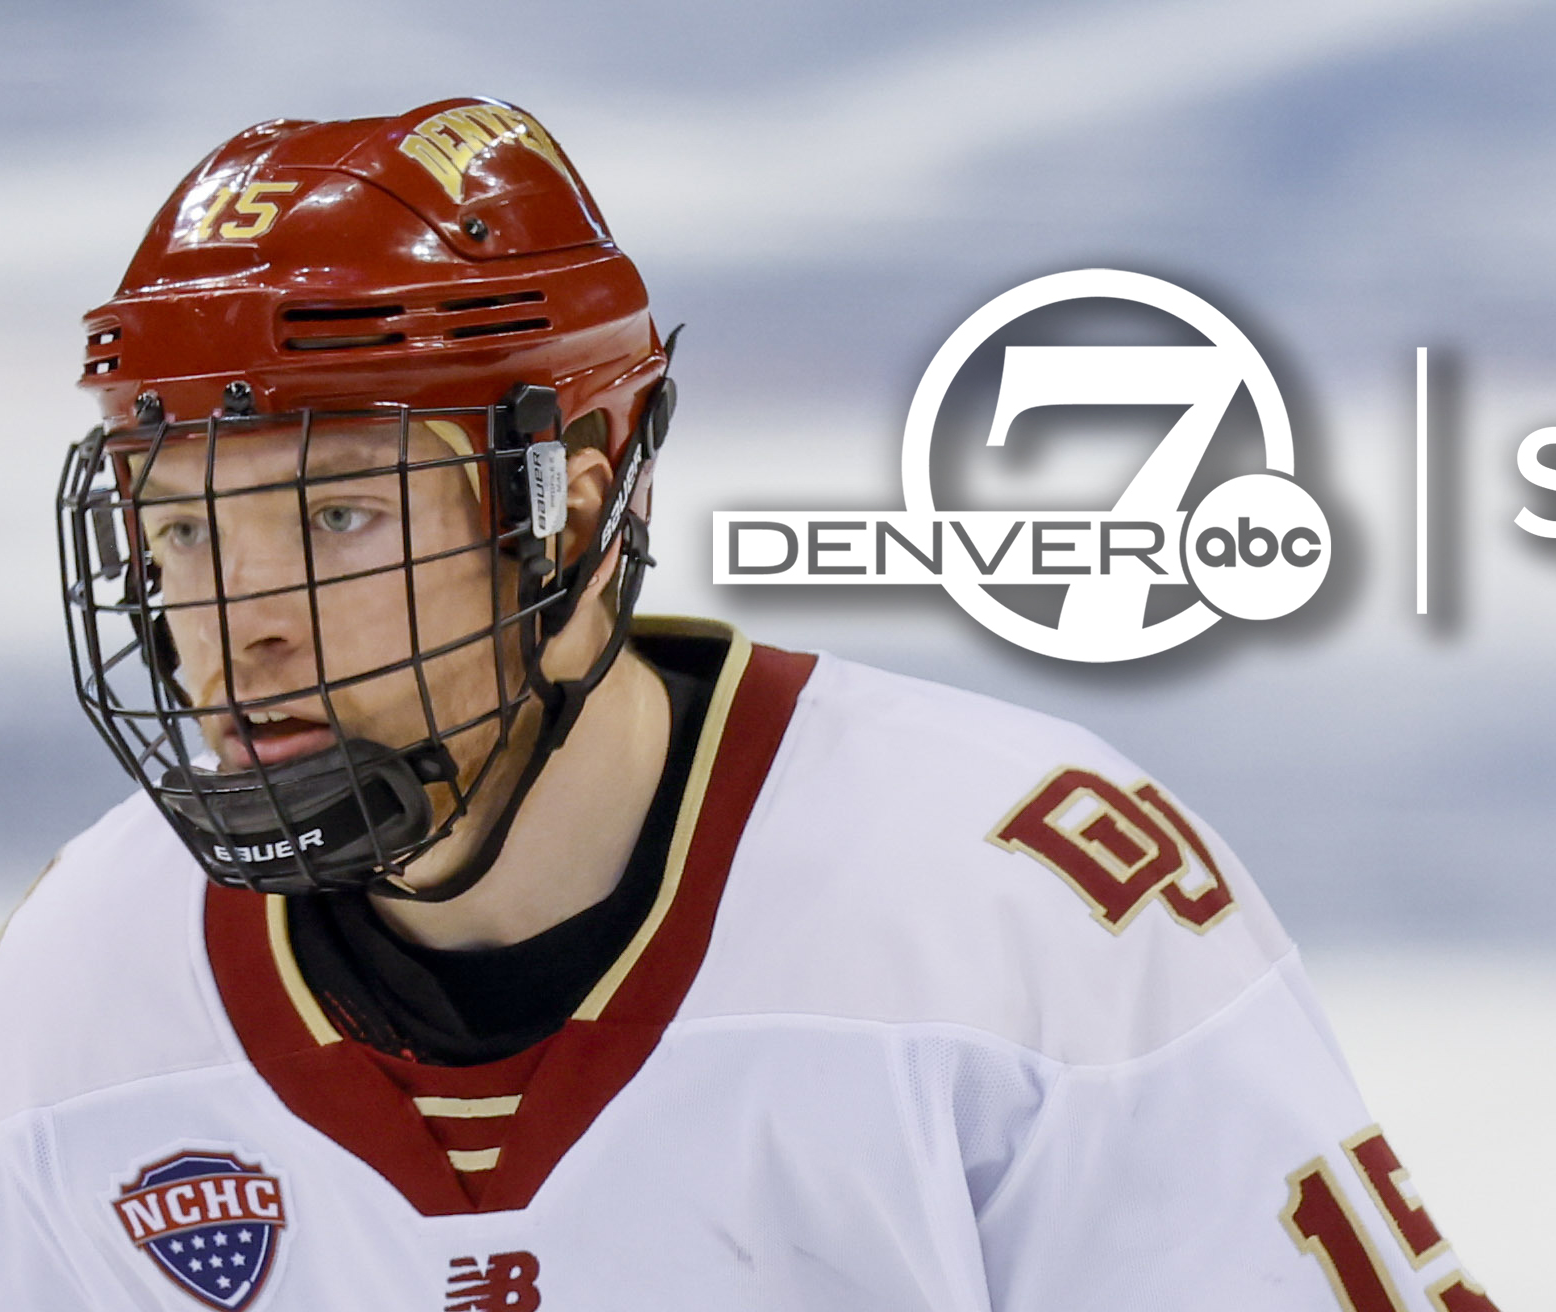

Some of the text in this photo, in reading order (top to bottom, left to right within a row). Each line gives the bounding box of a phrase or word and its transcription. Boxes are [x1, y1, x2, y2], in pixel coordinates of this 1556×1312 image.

[185, 181, 298, 240] 15
[985, 764, 1239, 936] DU
[120, 1177, 280, 1238] NCHC
